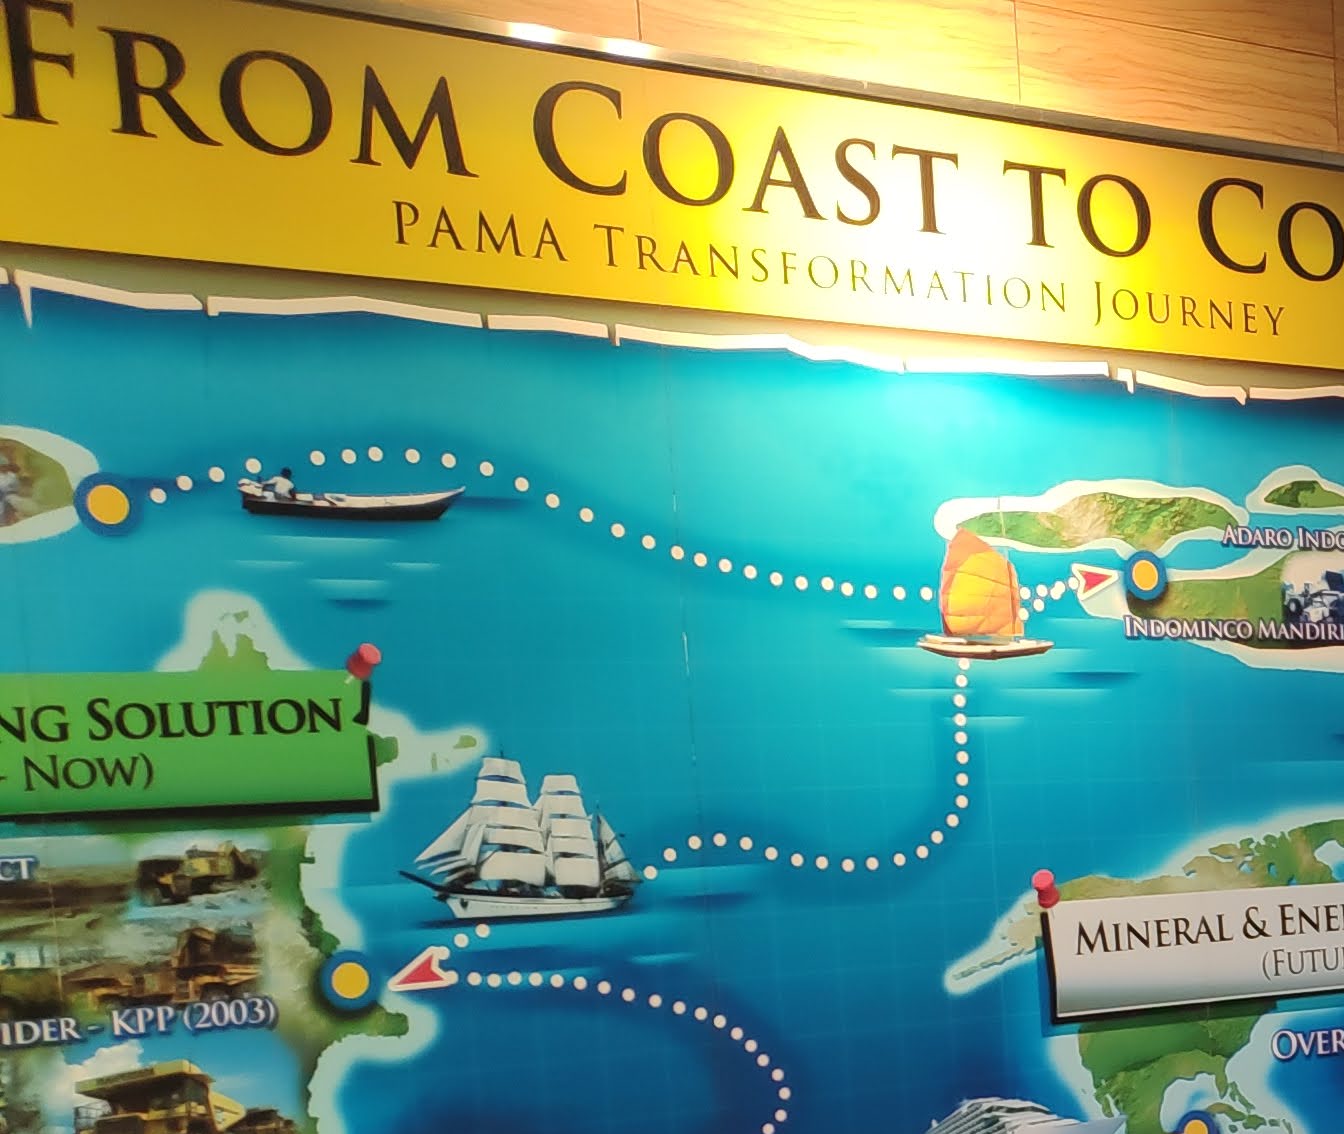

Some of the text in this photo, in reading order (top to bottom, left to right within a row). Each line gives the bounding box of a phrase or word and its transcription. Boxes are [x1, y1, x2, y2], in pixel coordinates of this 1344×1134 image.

[3, 0, 480, 178] FROM
[532, 81, 959, 234] COAST
[1003, 160, 1151, 258] TO
[392, 200, 1286, 336] PAMA TRANSFORMATION JOURNEY
[1222, 525, 1292, 548] ADARO
[1124, 616, 1253, 640] INDOMINCO
[87, 698, 343, 741] SOLUTION
[23, 752, 155, 791] NOW)
[1075, 912, 1234, 956] MINERAL
[1242, 906, 1270, 940] &
[111, 1005, 175, 1037] KPP
[183, 998, 277, 1031] (2003)
